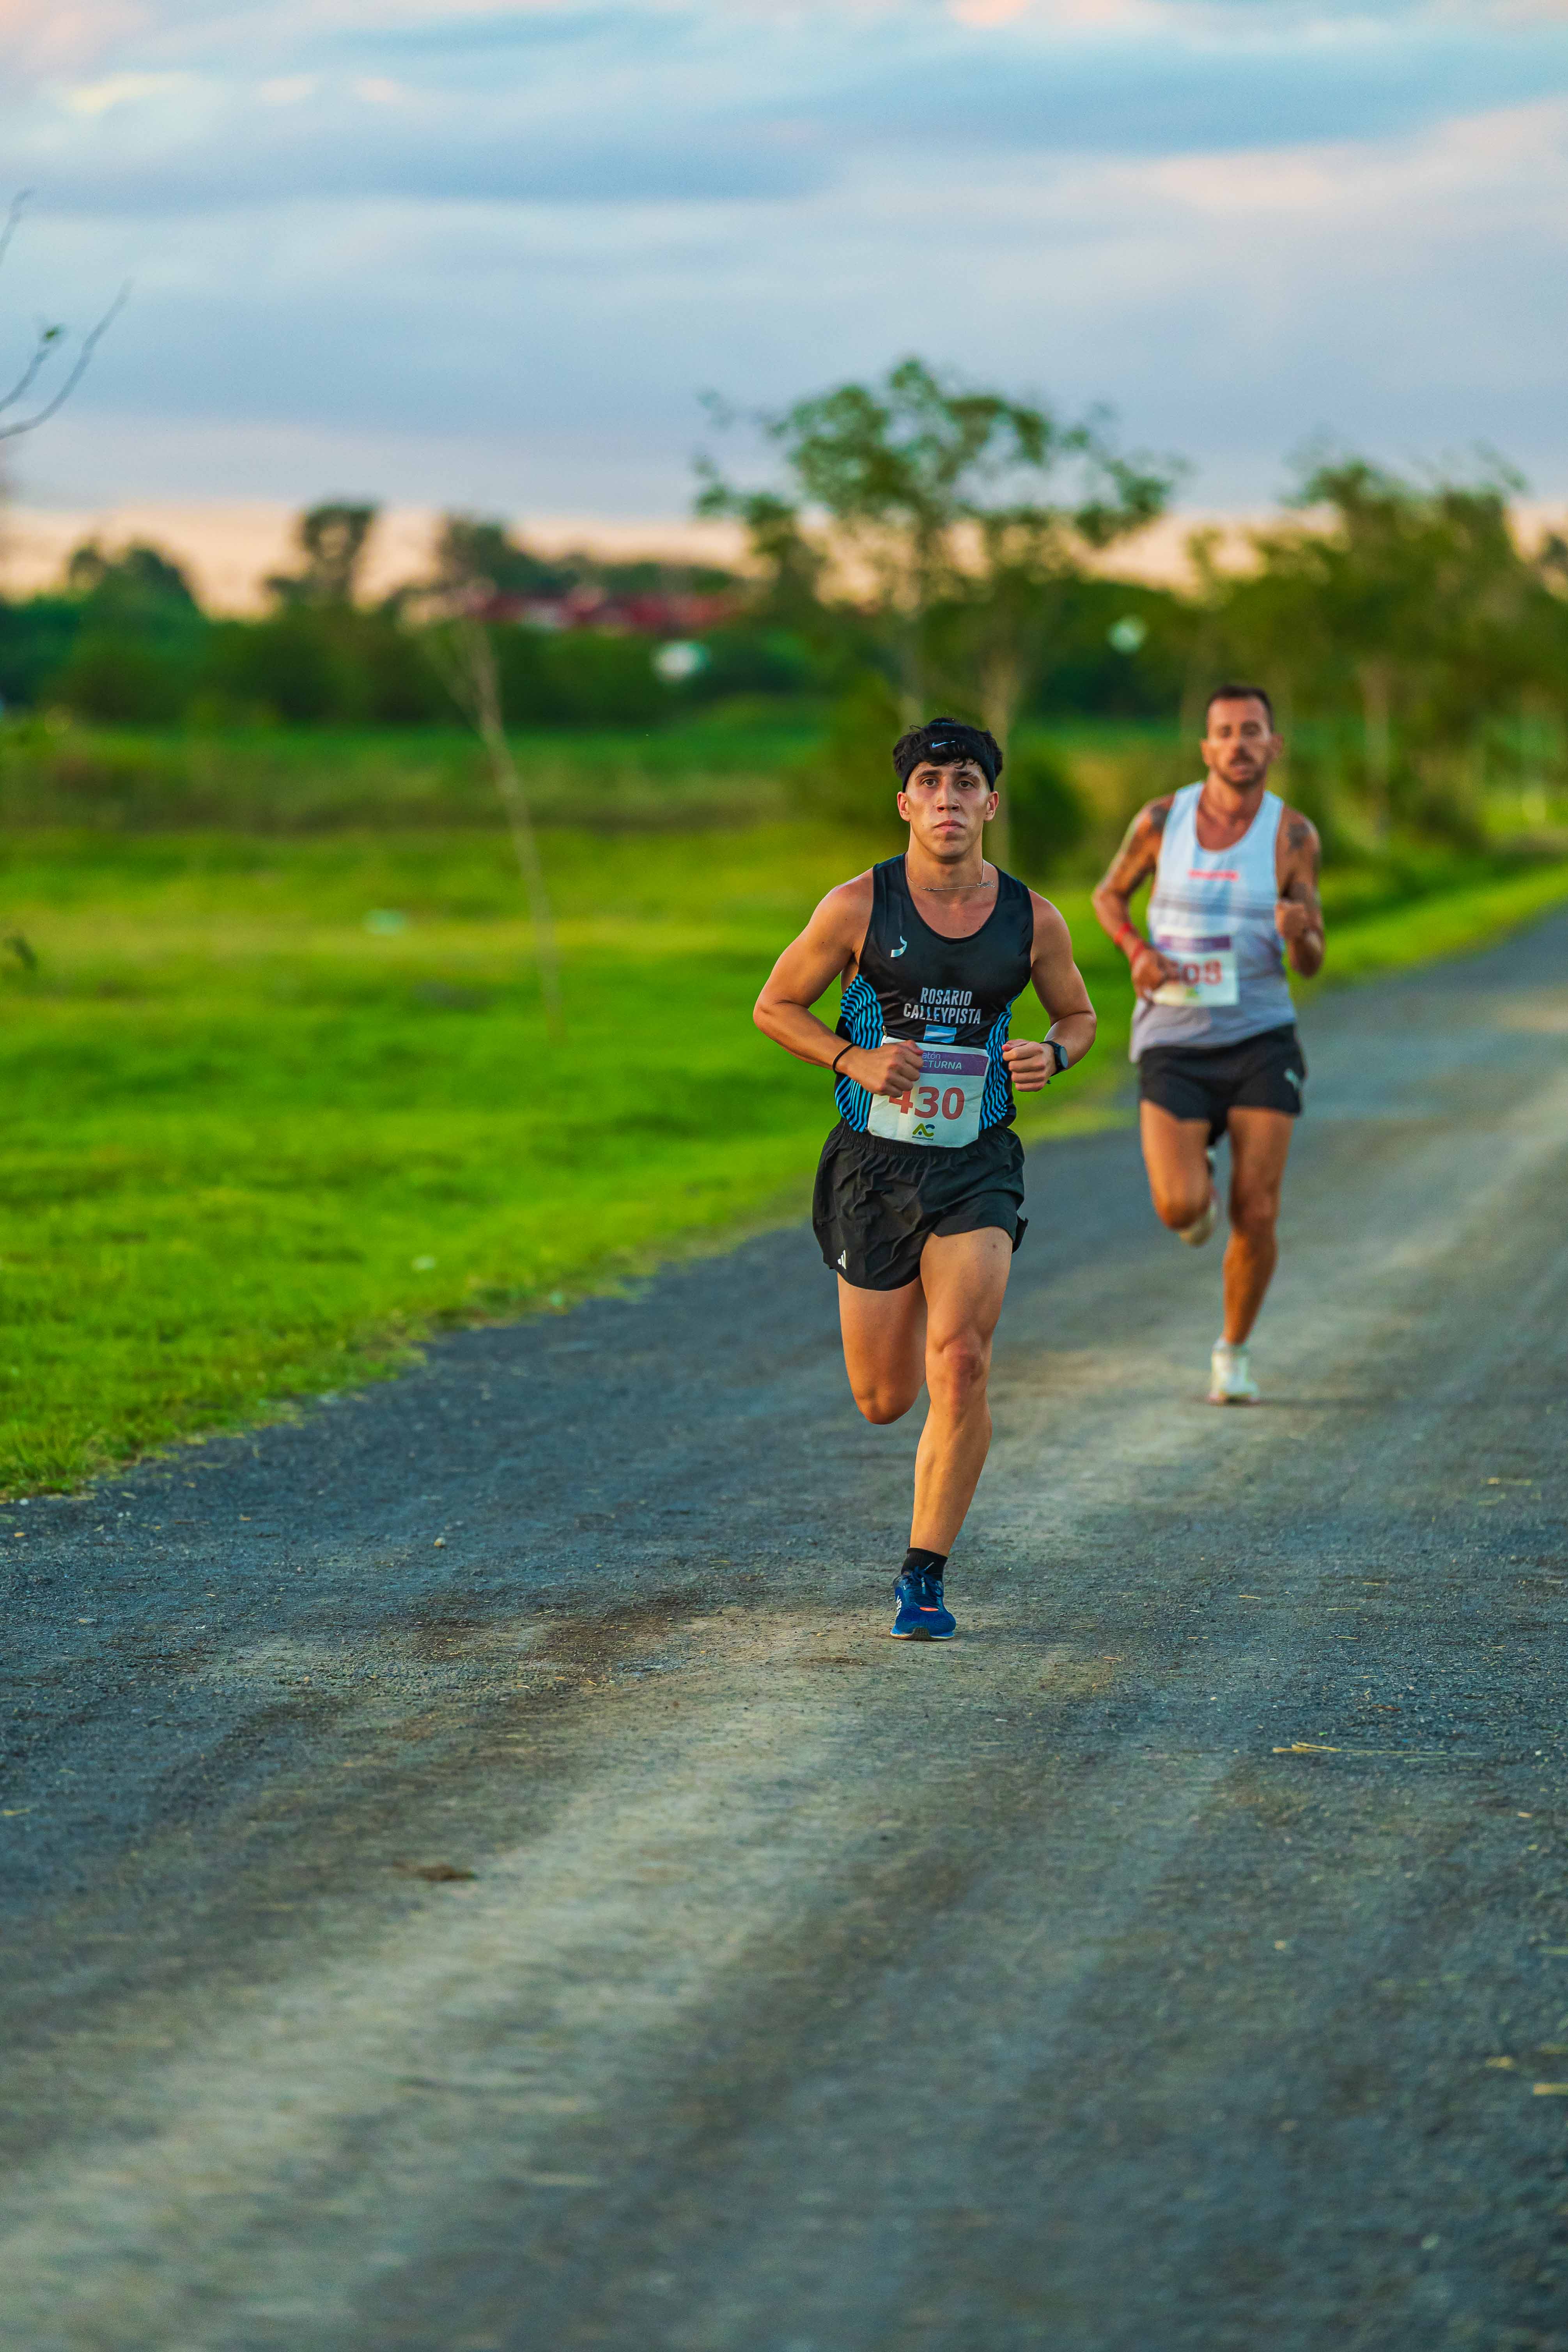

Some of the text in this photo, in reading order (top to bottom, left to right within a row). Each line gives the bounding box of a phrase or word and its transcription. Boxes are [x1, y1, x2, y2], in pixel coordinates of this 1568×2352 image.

[1171, 958, 1223, 986] 08
[920, 987, 973, 1006] ROSARIO
[903, 1003, 982, 1024] CALLEYPISTA
[922, 1051, 941, 1060] atón
[923, 1059, 962, 1070] CTURNA
[888, 1086, 965, 1120] 430
